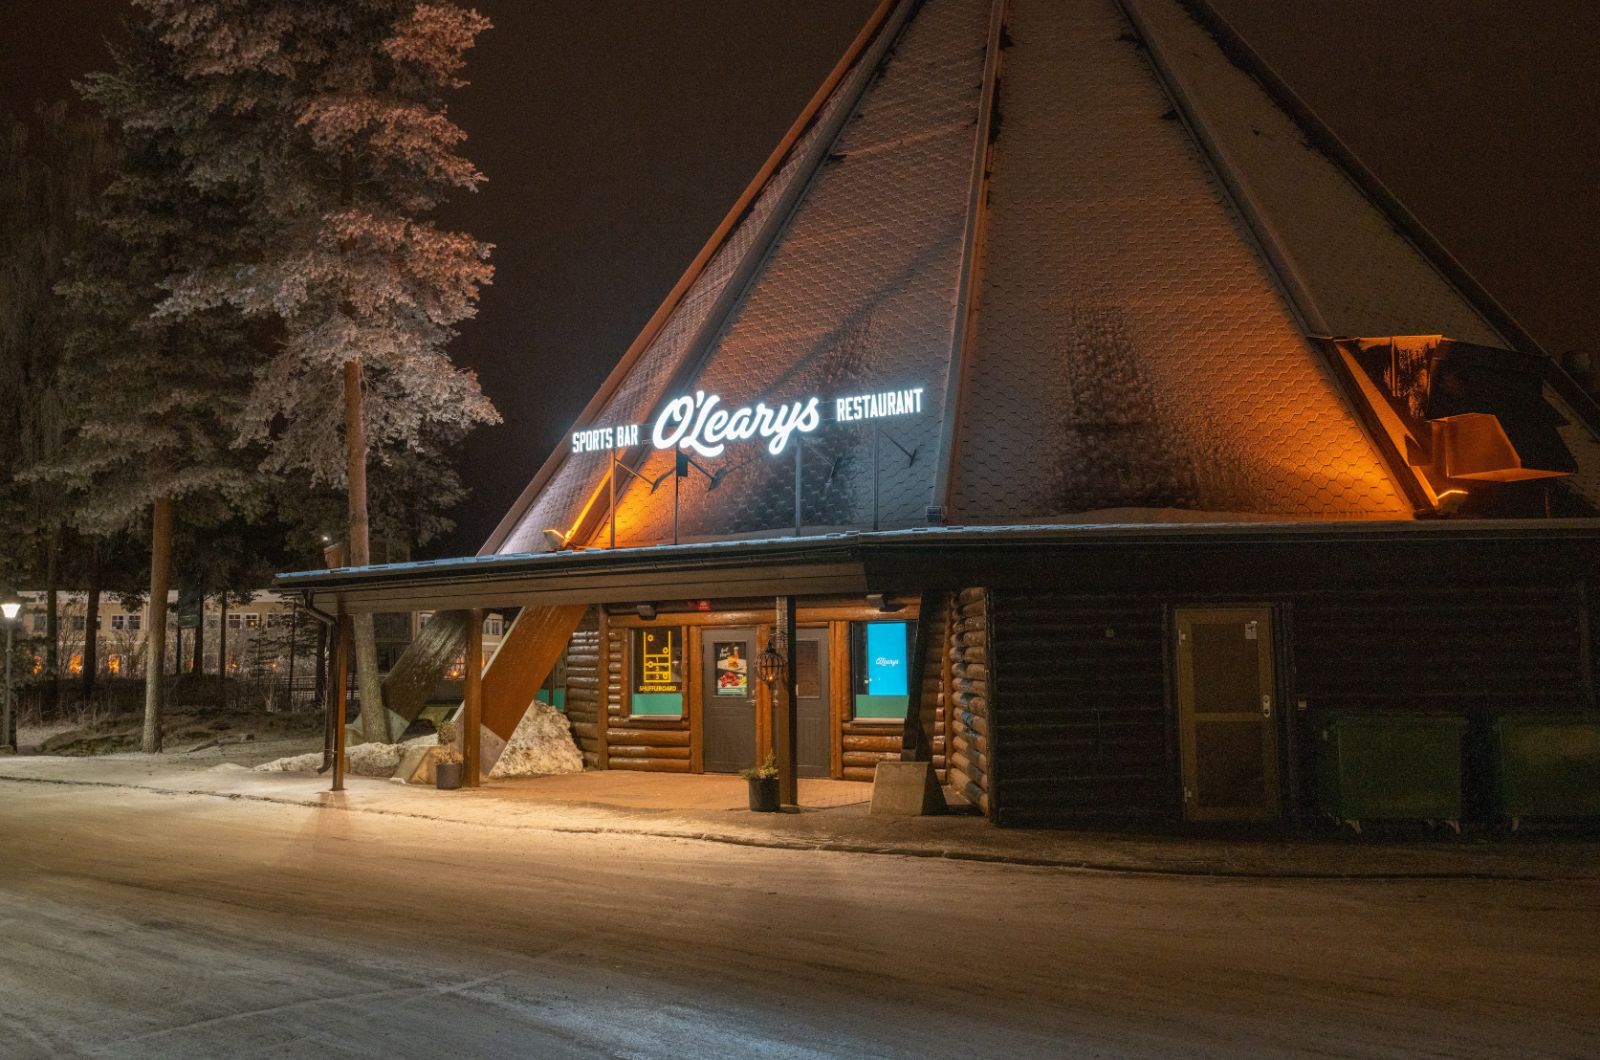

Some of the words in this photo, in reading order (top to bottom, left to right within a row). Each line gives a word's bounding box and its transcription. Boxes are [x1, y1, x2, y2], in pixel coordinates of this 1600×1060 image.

[572, 428, 613, 453] SPORTS
[616, 425, 639, 447] BAR
[652, 390, 820, 457] O'Learys
[836, 388, 924, 422] RESTAURANT
